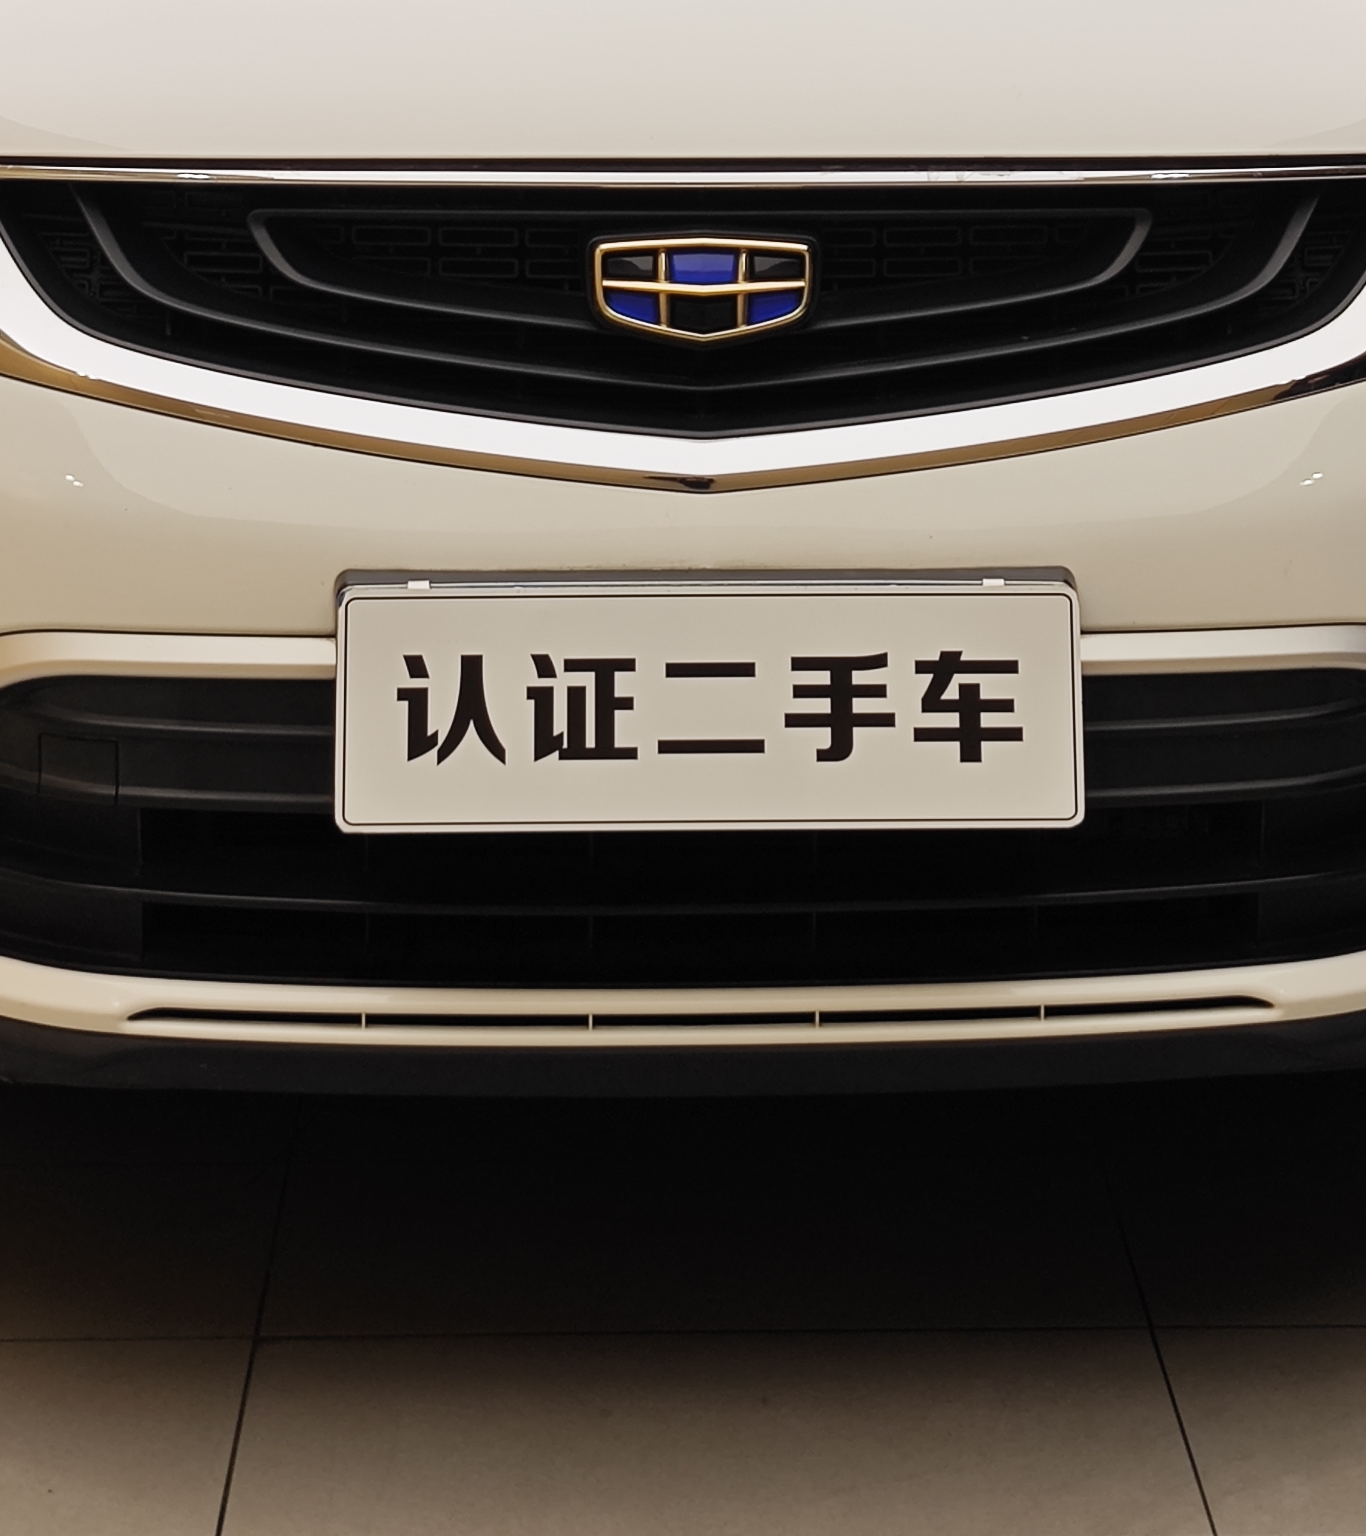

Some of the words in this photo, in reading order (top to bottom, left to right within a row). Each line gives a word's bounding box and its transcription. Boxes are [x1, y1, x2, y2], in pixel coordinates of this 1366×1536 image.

[396, 649, 1024, 767] 认证二手车
